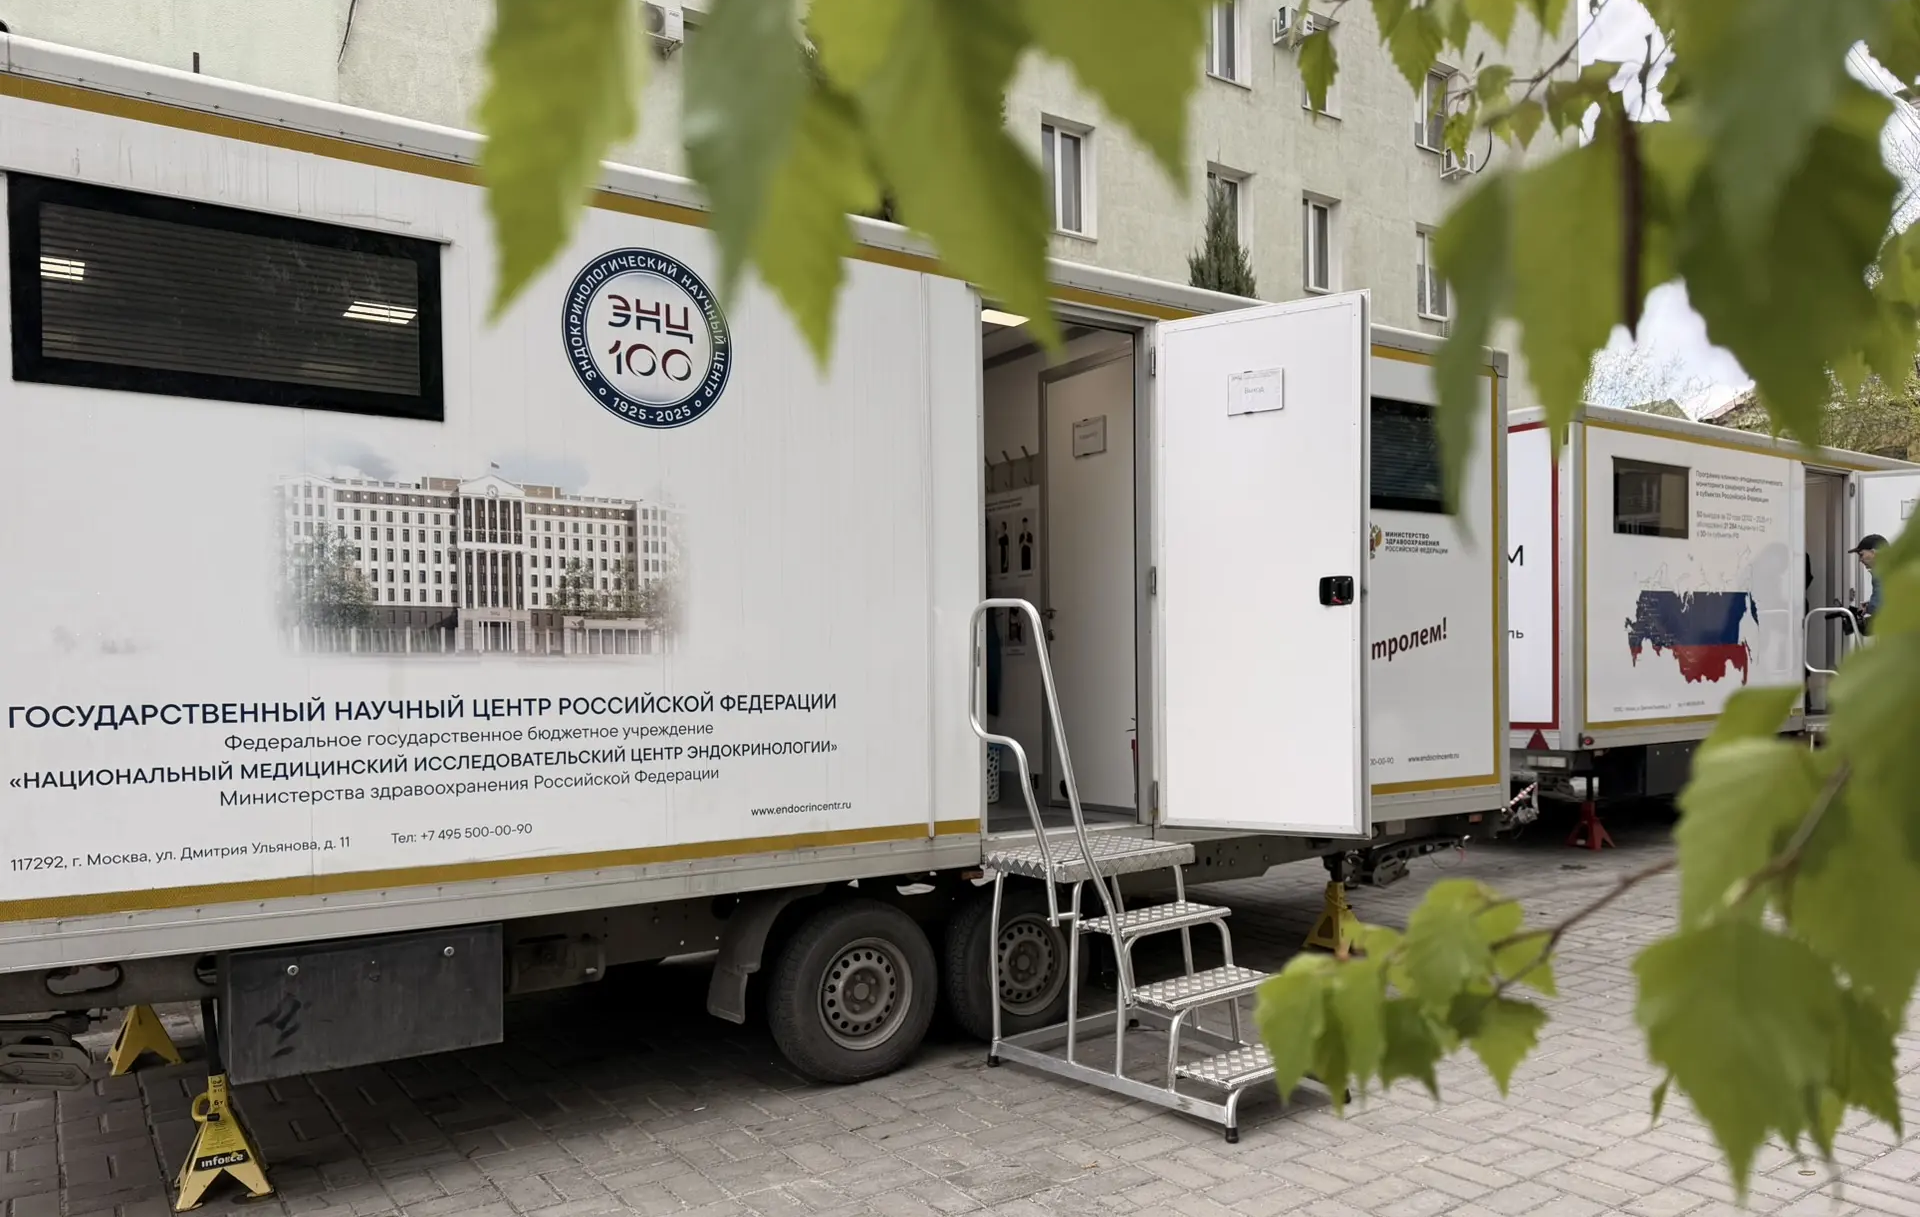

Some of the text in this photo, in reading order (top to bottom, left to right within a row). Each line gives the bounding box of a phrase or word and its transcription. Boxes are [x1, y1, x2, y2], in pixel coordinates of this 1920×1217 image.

[570, 255, 727, 398] ЭНДОКРИНОЛОГИЧЕСКИЙ НАУЧНЫЙ ЦЕНТР
[608, 294, 693, 344] ЭНЦ
[608, 340, 693, 382] 100
[613, 397, 691, 422] 1925-2025
[1385, 538, 1440, 547] ЗДРАВООХРАНЕНИЯ
[1371, 617, 1447, 661] тролем!
[9, 691, 837, 731] ГОСУДАРСТВЕННЫЙ НАУЧНЫЙ ЦЕНТР РОССИЙСКОЙ ФЕДЕРАЦИИ
[224, 722, 714, 752] Федеральное государственное бюджетное учреждение
[10, 740, 838, 790] «НАЦИОНАЛЬНЫЙ МЕДИЦИНСКИЙ ИССЛЕДОВАТЕЛЬСКИЙ ЦЕНТР ЭНДОКРИНОЛОГИИ»
[220, 768, 719, 806] Министерства здравоохранения Российской Федерации
[751, 801, 851, 817] www.endocrincentr.ru
[391, 823, 533, 844] Тел: +7 495 500-00-90
[11, 836, 350, 871] 117292, г. Москва, ул. Дмитрия Ульянова, д. 11
